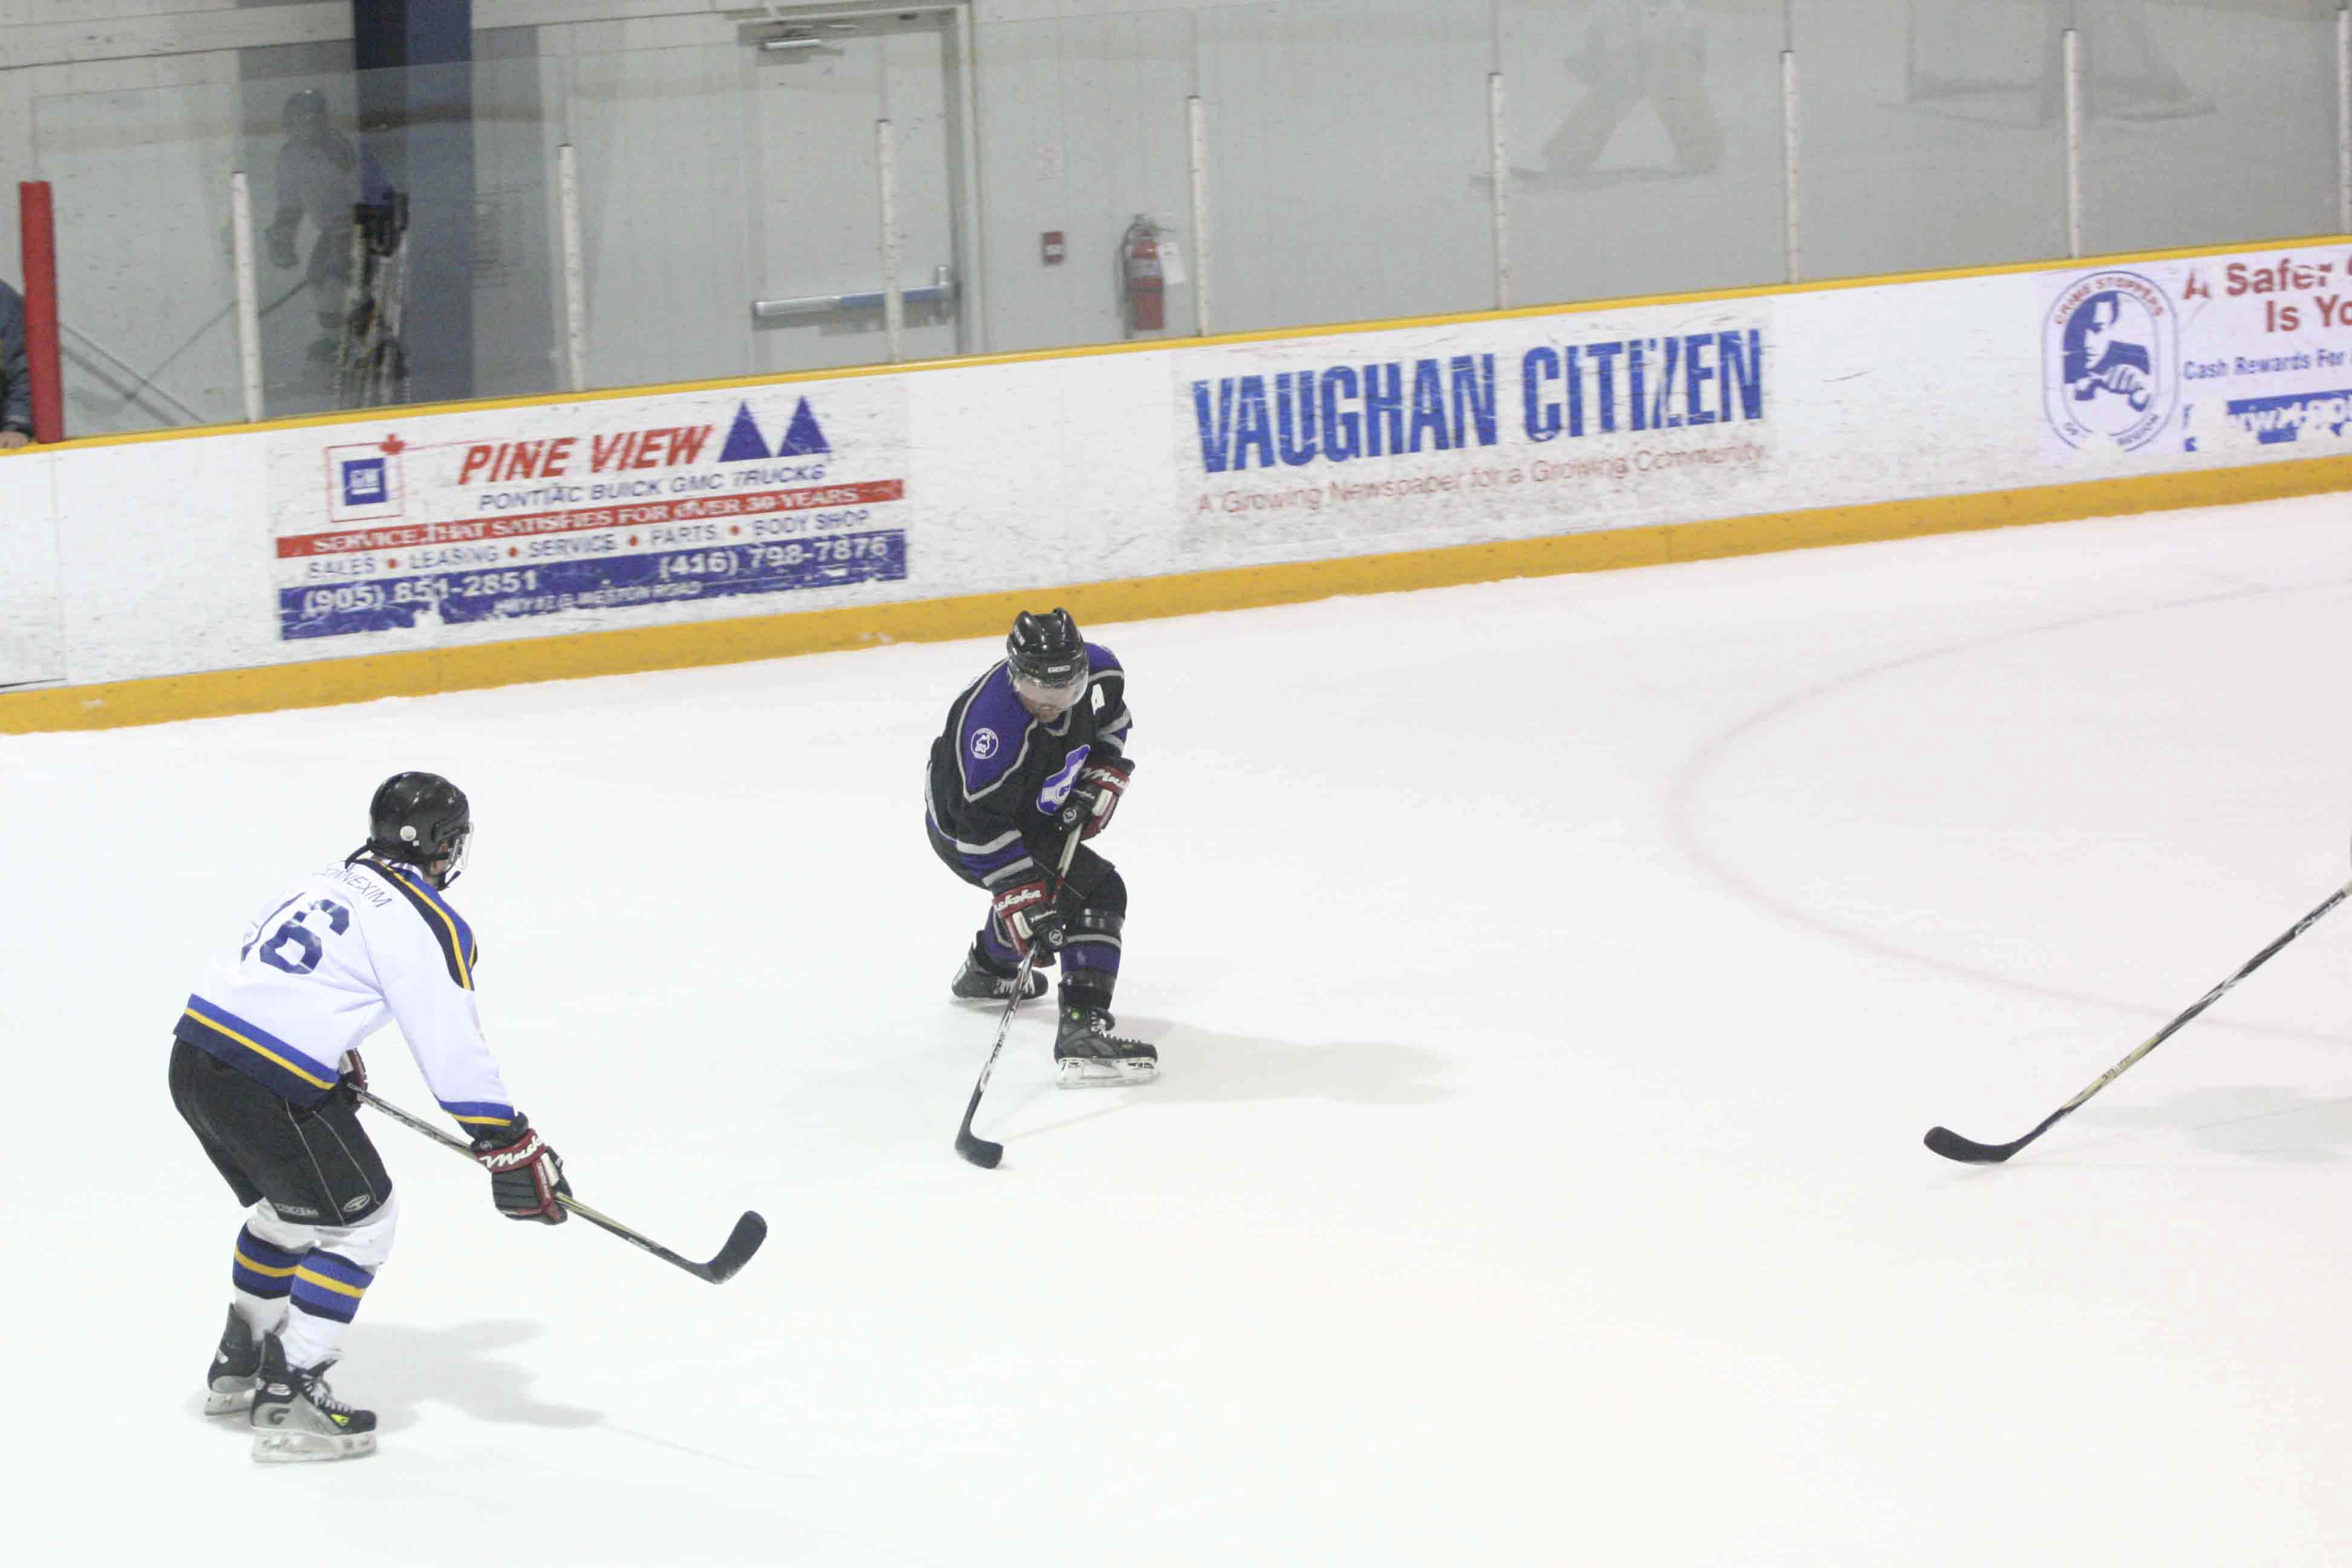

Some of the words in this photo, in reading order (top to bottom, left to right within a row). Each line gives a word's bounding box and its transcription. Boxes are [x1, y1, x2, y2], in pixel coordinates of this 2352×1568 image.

[2226, 258, 2332, 296] Safer
[2265, 301, 2301, 333] Is
[2184, 359, 2227, 380] Cash
[2235, 354, 2310, 376] Rewards
[2318, 348, 2345, 367] For
[1191, 353, 1498, 473] VAUGHAN
[1522, 328, 1763, 443] CITIZEN
[457, 436, 577, 485] PINE
[590, 424, 714, 474] VIEW
[1197, 492, 1214, 513] A
[1221, 486, 1322, 513] Growing
[1330, 471, 1462, 503] Newspaper
[1471, 467, 1501, 488] for
[1508, 468, 1523, 484] a
[1530, 455, 1627, 483] Growing
[479, 483, 582, 511] PONTIAC
[590, 478, 662, 500] BUICK
[669, 472, 724, 492] GMC
[733, 463, 826, 487] TRUCKS
[309, 556, 376, 578] SALES
[408, 544, 498, 570] LEASING
[527, 533, 616, 558] SERVICE
[650, 524, 718, 546] PARTS
[752, 515, 809, 537] BODY
[814, 509, 871, 531] SHOP
[313, 529, 418, 554] SERVICE
[426, 520, 485, 543] THAT
[492, 508, 612, 537] SATISFIES
[619, 503, 669, 524] FOR
[674, 495, 740, 519] OVER
[782, 487, 860, 509] YEARS
[302, 583, 385, 619] (905)
[393, 570, 537, 603] 851-2851
[658, 550, 739, 580] (416)
[749, 536, 888, 569] 798-7876
